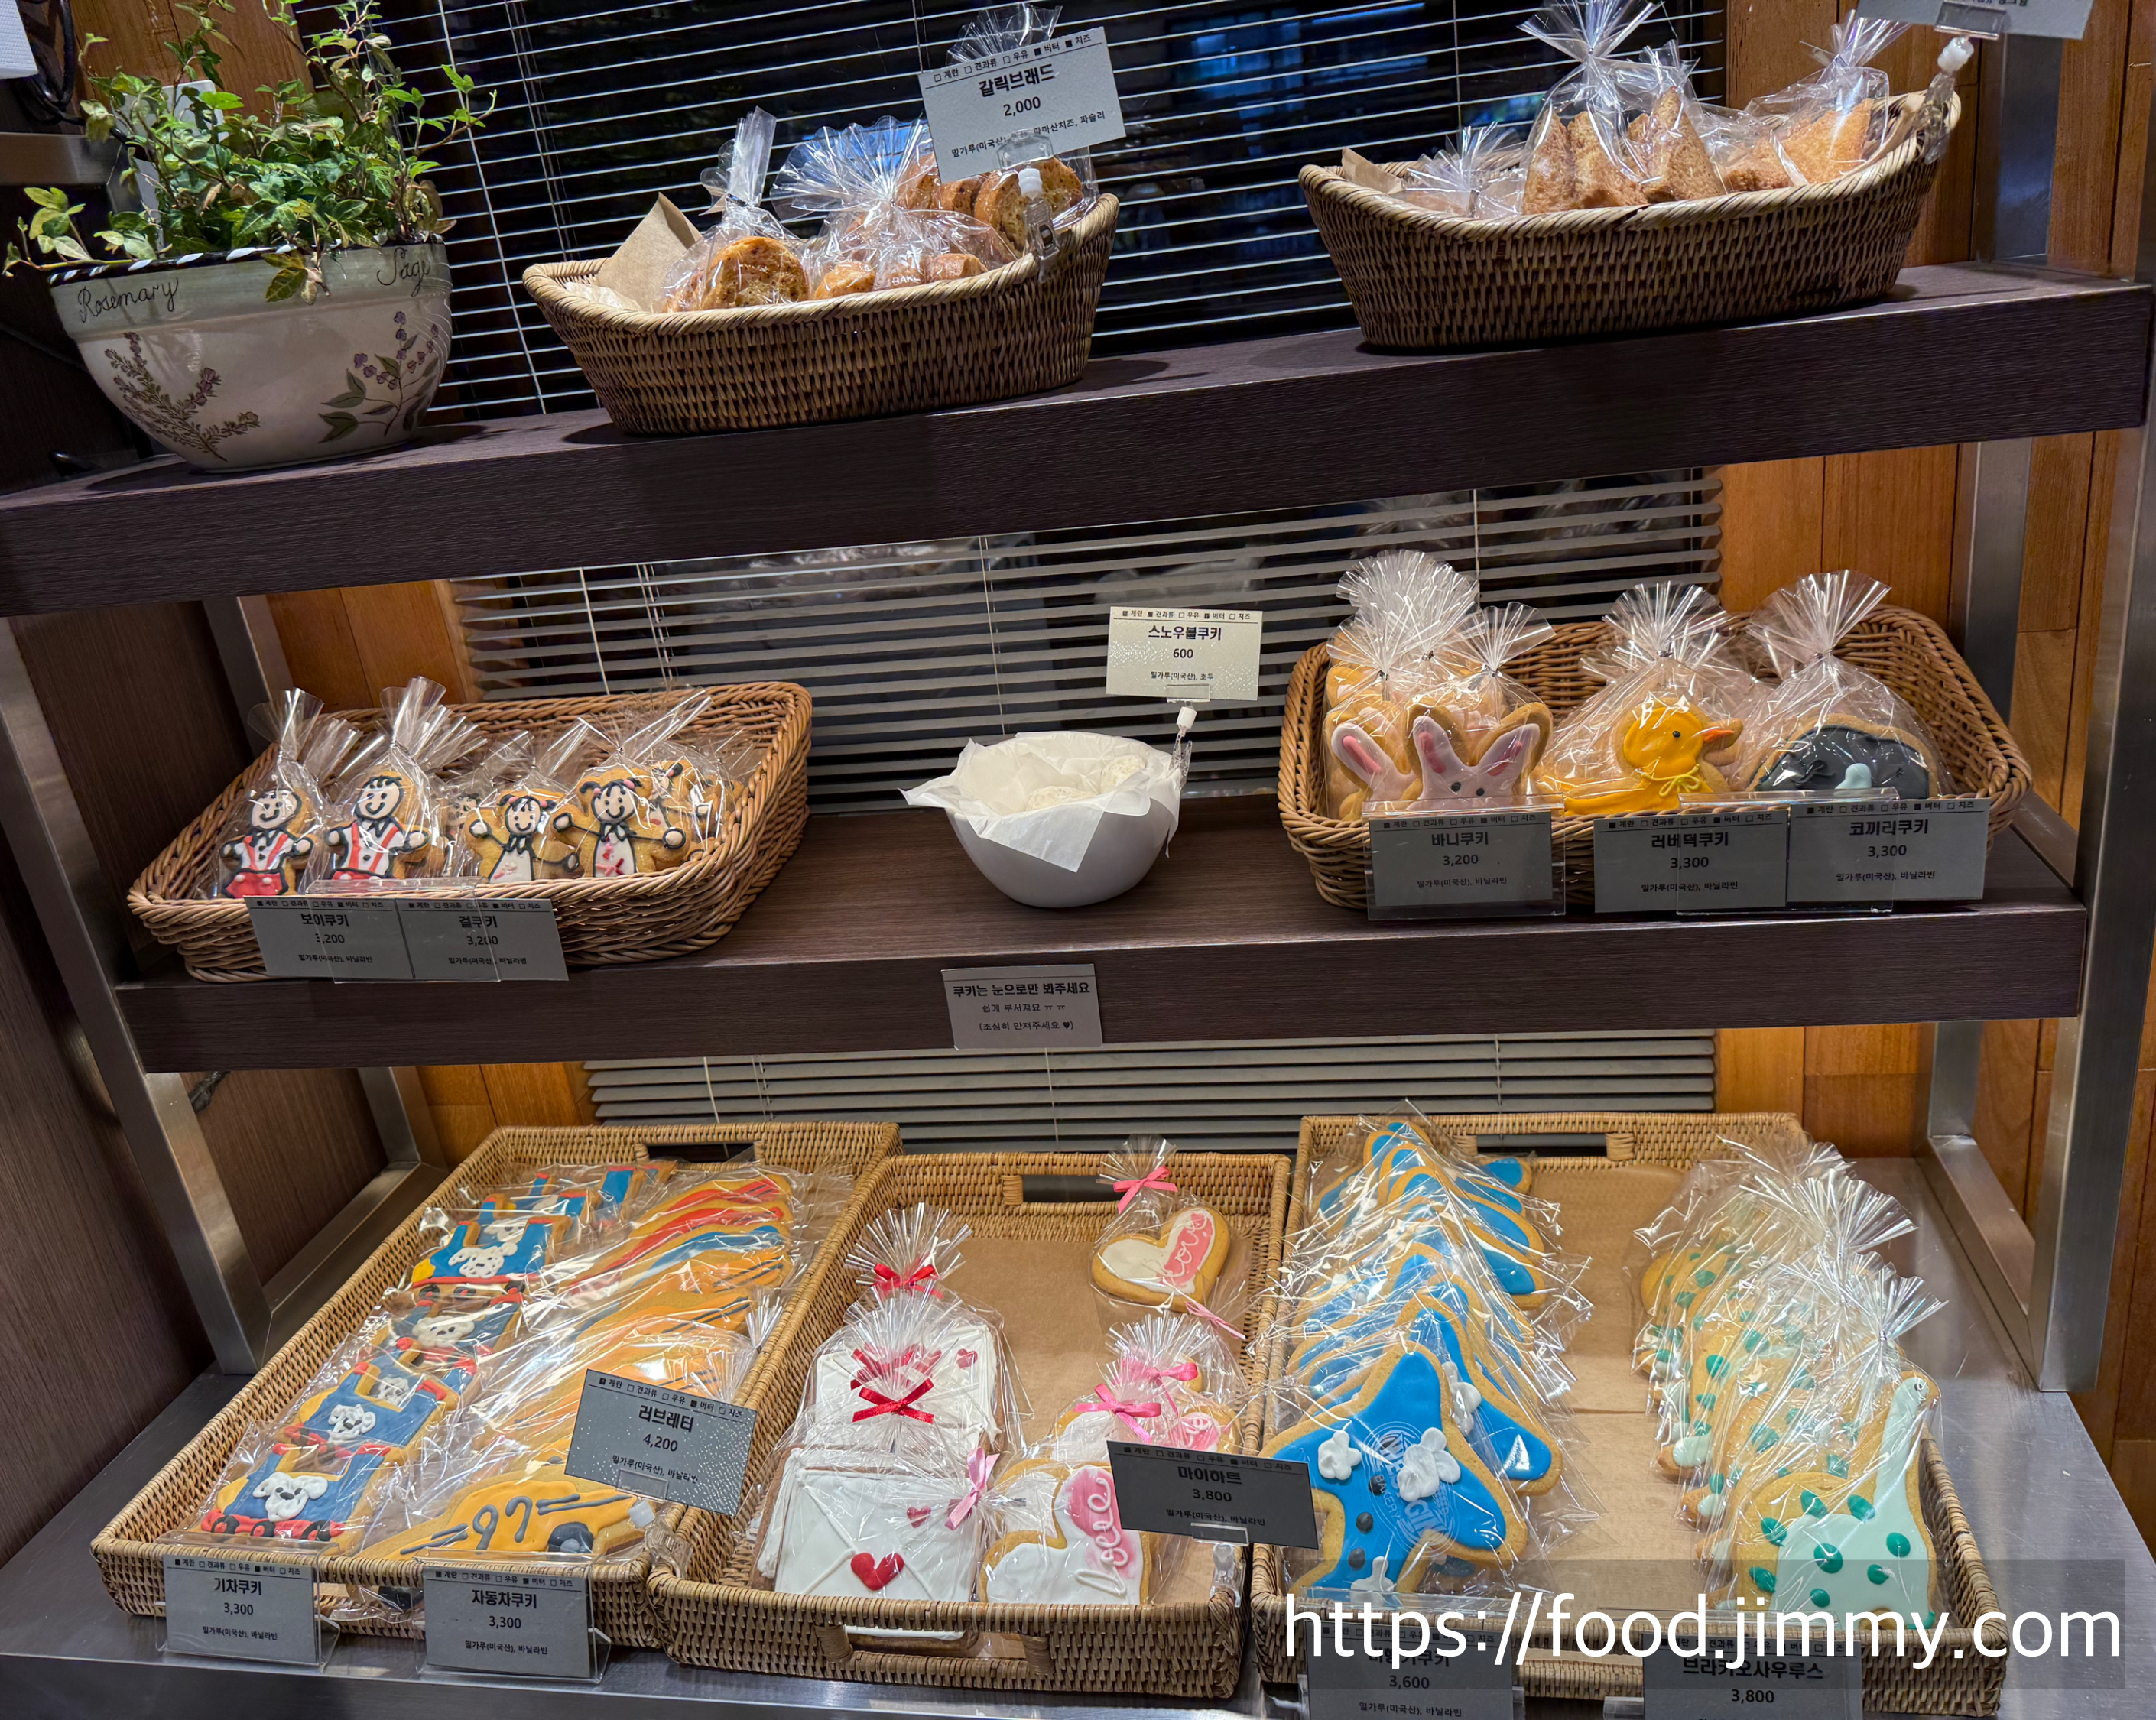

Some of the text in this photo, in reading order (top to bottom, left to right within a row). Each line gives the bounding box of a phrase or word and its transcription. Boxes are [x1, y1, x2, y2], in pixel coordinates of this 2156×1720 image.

[943, 35, 1092, 79] 계란 견과류 우유 버터 치즈
[979, 64, 1056, 97] 갈릭브래드
[1003, 96, 1041, 116] 2,000
[1080, 112, 1105, 123] 파슬리
[78, 277, 179, 323] Rosemary
[1148, 625, 1222, 640] 스노우볼쿠키
[1173, 649, 1193, 658] 600
[1151, 672, 1197, 681] 밀가루(미국산),
[1958, 800, 1974, 809] 치즈
[1651, 818, 1674, 826] 견과류
[1849, 819, 1928, 836] 코끼리쿠키
[1432, 832, 1489, 846] 바니쿠키
[1651, 832, 1729, 849] 러버덕쿠키
[1868, 845, 1907, 858] 3,300
[1443, 854, 1479, 866] 3,200
[1671, 857, 1709, 869] 3,300
[1417, 878, 1472, 888] 밀가루(미국산),
[1836, 871, 1935, 881] 밀가루(미국산), 바닐라빈
[1641, 881, 1738, 892] 밀가루(미국산), 바닐라빈
[301, 914, 349, 927] 보이쿠키
[459, 916, 498, 928] 걸쿠키
[467, 936, 498, 946] 3,200
[299, 954, 345, 962] 밀가루(미국산),
[953, 982, 1089, 998] 쿠키는 눈으로만 봐주세요
[979, 1022, 1010, 1031] (조심히
[608, 1378, 742, 1417] 계란 견과류 우유 버터 치즈
[638, 1405, 694, 1432] 러브레터
[643, 1433, 678, 1452] 4,200
[612, 1454, 664, 1476] 밀가루(미국산),
[1167, 1450, 1190, 1459] 견과류
[1208, 1455, 1224, 1463] 우유
[1242, 1459, 1258, 1467] 버터
[1275, 1462, 1292, 1471] 치즈
[1178, 1466, 1242, 1485] 마이하트
[1193, 1489, 1232, 1502] 3,800
[1166, 1508, 1265, 1526] 밀가루(미국산), 바닐라빈
[472, 1495, 534, 1554] 97
[214, 1578, 261, 1595] 기차쿠키
[532, 1577, 545, 1585] 버터
[559, 1579, 573, 1587] 치즈
[472, 1589, 537, 1608] 자동차쿠키
[224, 1602, 254, 1615] 3,300
[489, 1616, 521, 1629] 3,300
[203, 1626, 278, 1640] 밀가루(미국산), 바닐라빈
[1478, 1634, 1495, 1643] 치즈
[465, 1640, 547, 1654] 밀가루(미국산), 바닐라빈
[1708, 1640, 1734, 1649] 견과류
[1389, 1675, 1430, 1689] 3,600
[1731, 1689, 1774, 1703] 3,800
[1359, 1702, 1462, 1717] 밀가루(미국산), 바닐라빈
